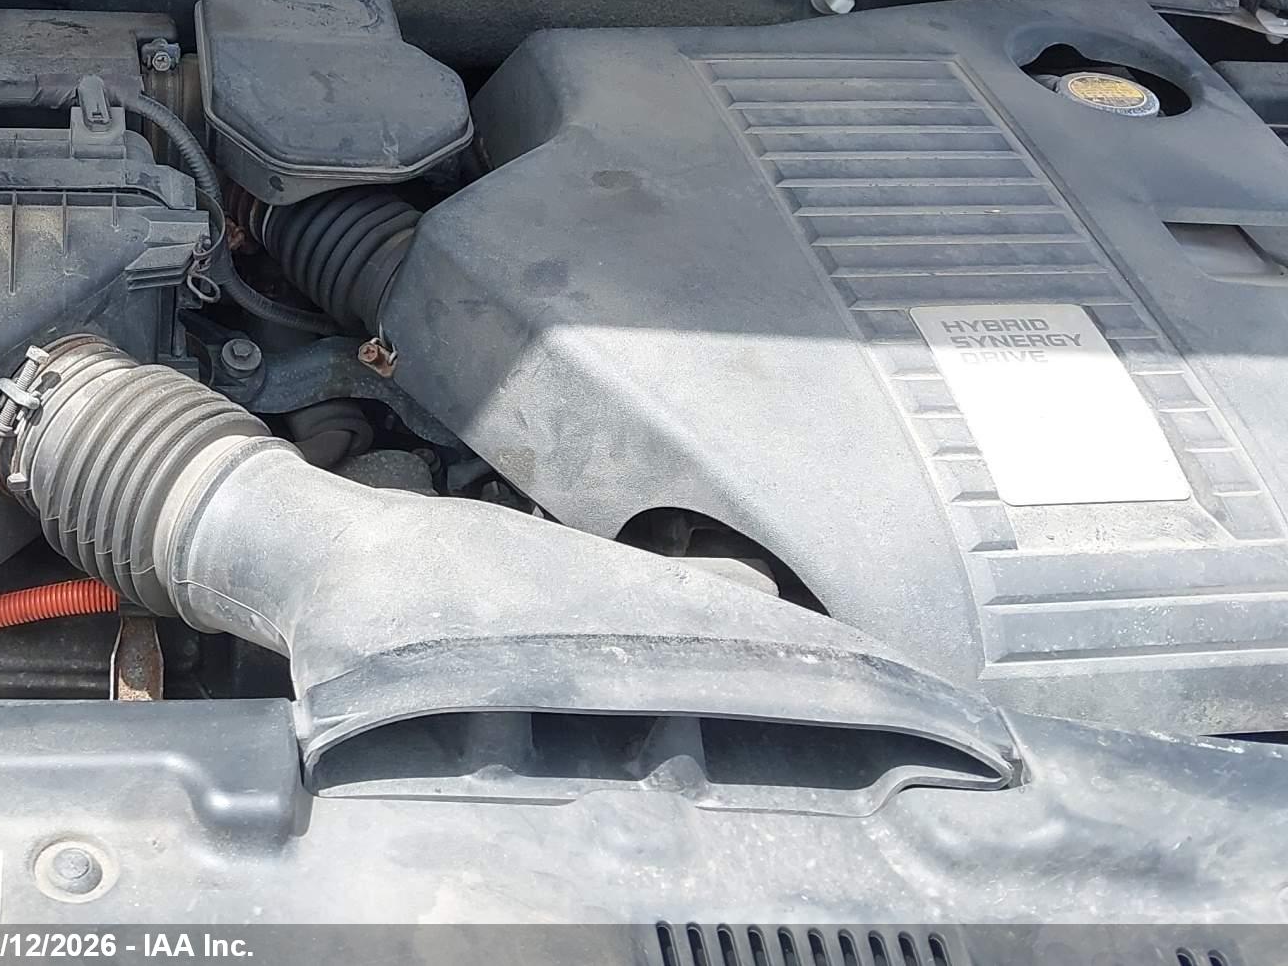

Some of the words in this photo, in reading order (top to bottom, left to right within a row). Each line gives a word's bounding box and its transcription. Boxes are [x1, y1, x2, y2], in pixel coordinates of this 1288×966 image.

[940, 319, 1050, 333] HYBRID
[950, 334, 1082, 348] SYNERGY
[960, 350, 1049, 363] DRIVE
